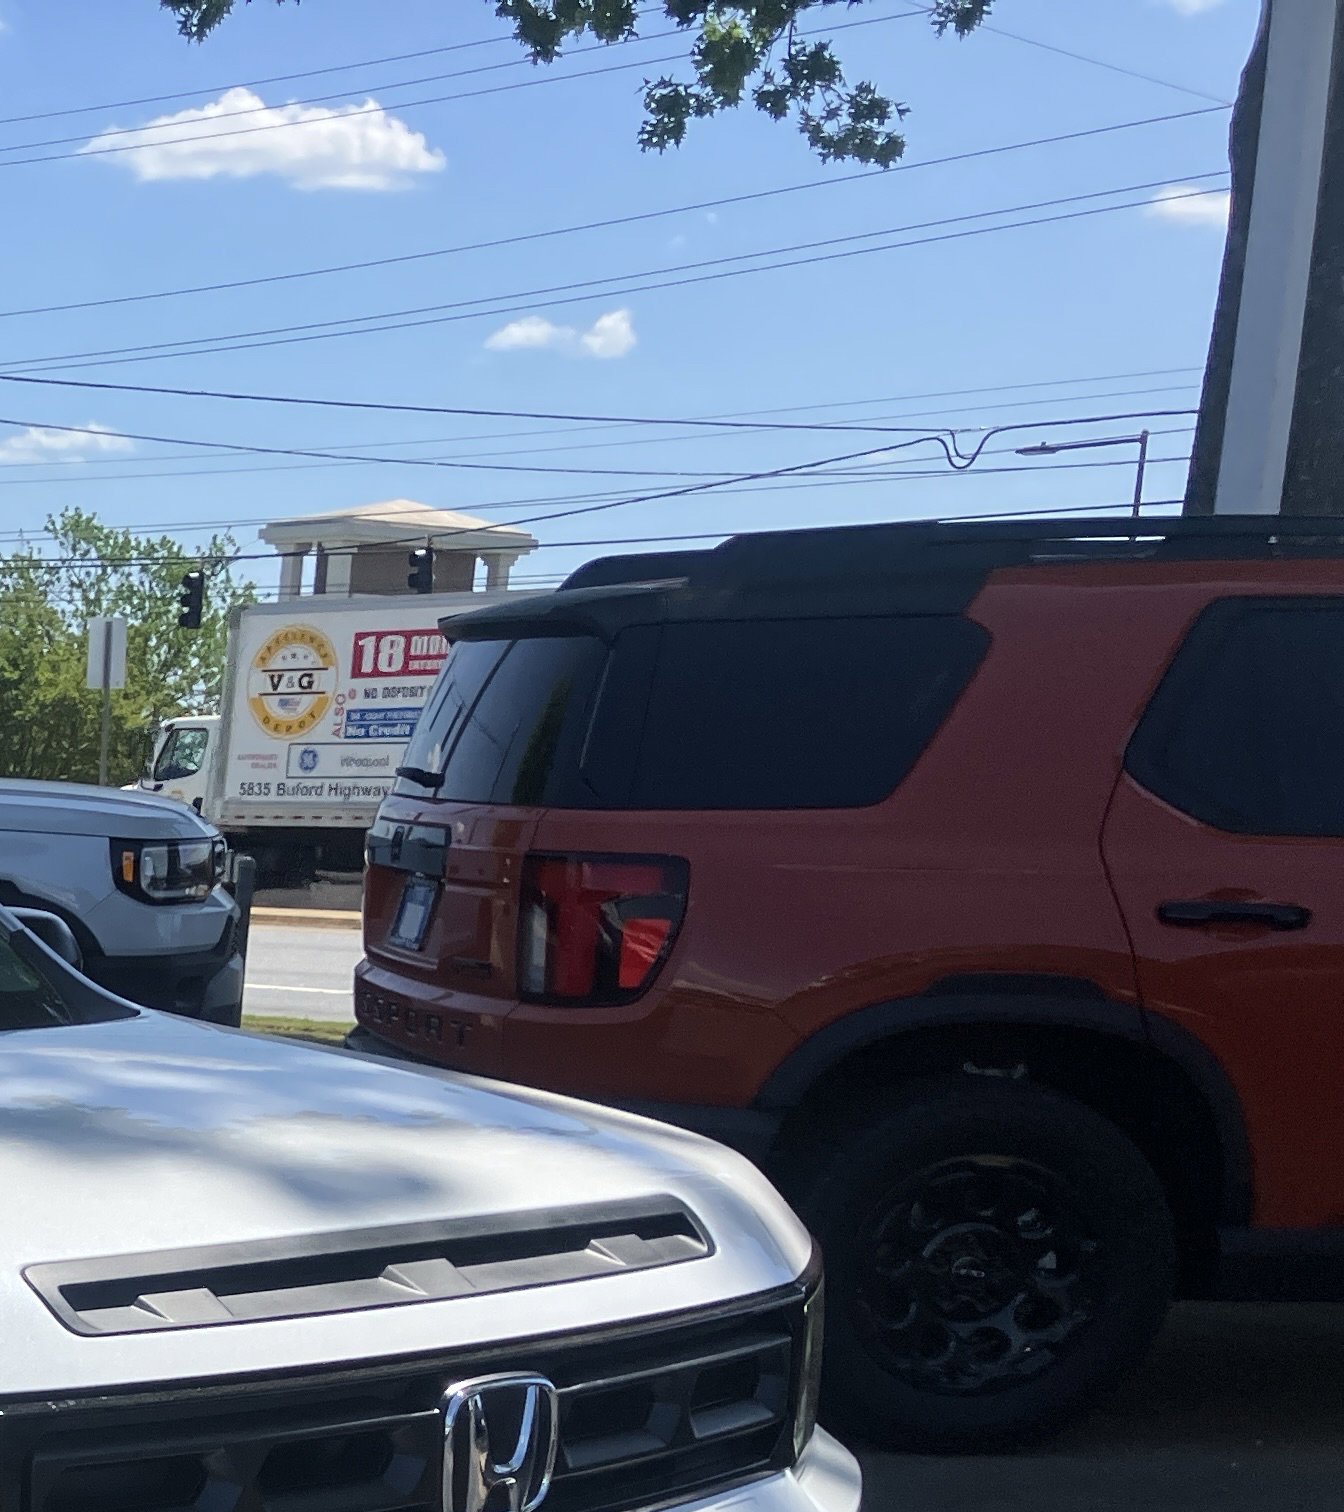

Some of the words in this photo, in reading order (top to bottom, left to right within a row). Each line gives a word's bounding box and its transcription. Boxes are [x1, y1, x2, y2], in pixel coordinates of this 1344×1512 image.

[358, 634, 405, 674] 18
[262, 710, 317, 733] DEPOT
[331, 693, 347, 739] ALSO
[368, 722, 411, 737] Credit
[238, 782, 271, 796] 5835
[276, 781, 323, 796] Buford
[327, 782, 392, 800] Highway
